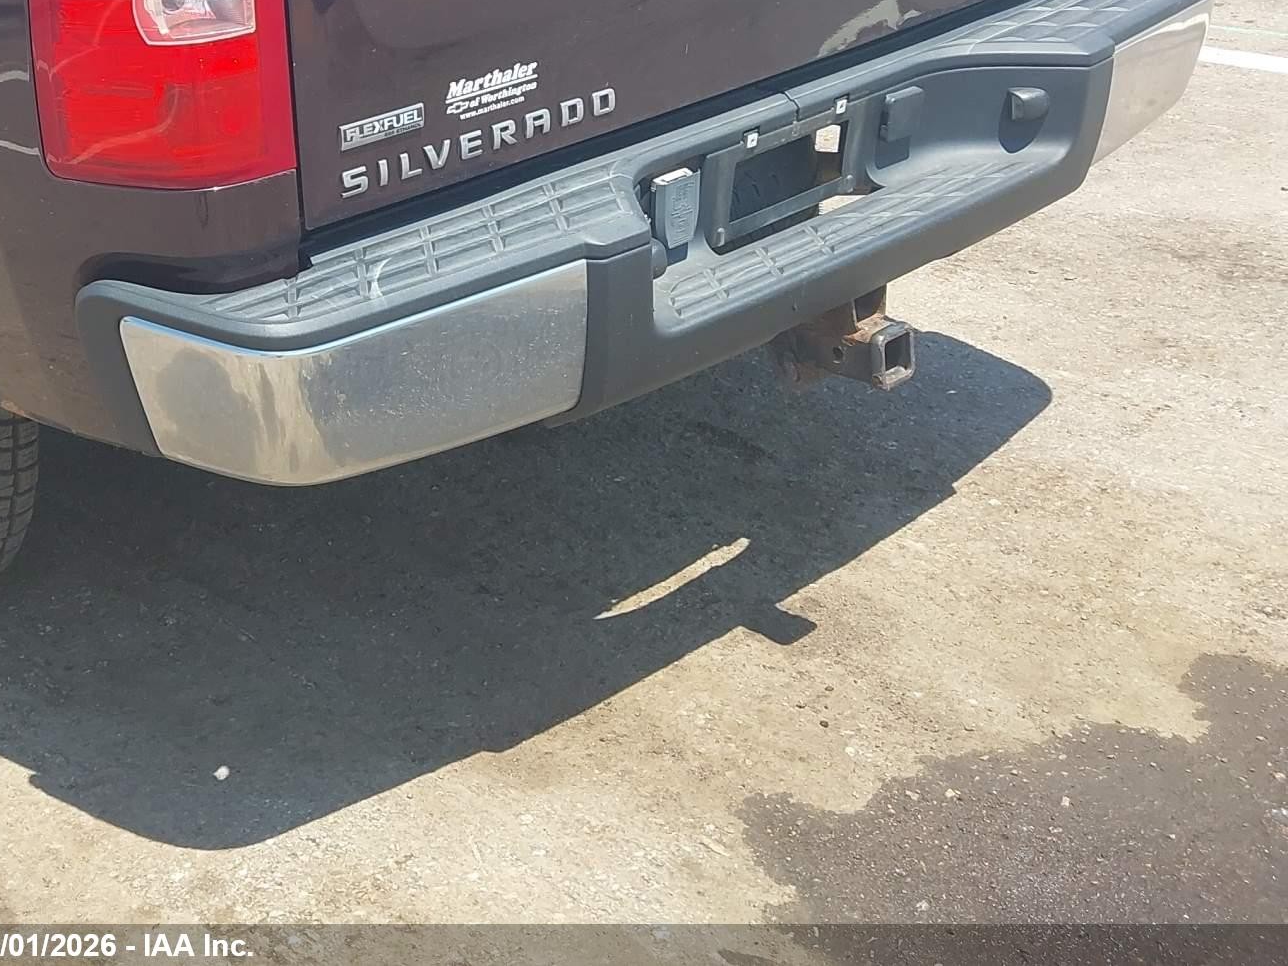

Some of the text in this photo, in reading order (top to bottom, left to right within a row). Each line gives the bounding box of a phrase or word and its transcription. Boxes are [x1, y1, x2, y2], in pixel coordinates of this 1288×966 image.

[446, 61, 538, 100] Marthaler
[469, 81, 537, 108] of Worthington
[459, 96, 525, 120] www.marthaler.com
[346, 110, 423, 143] FLEXFUEL
[341, 88, 616, 199] SILVERADO
